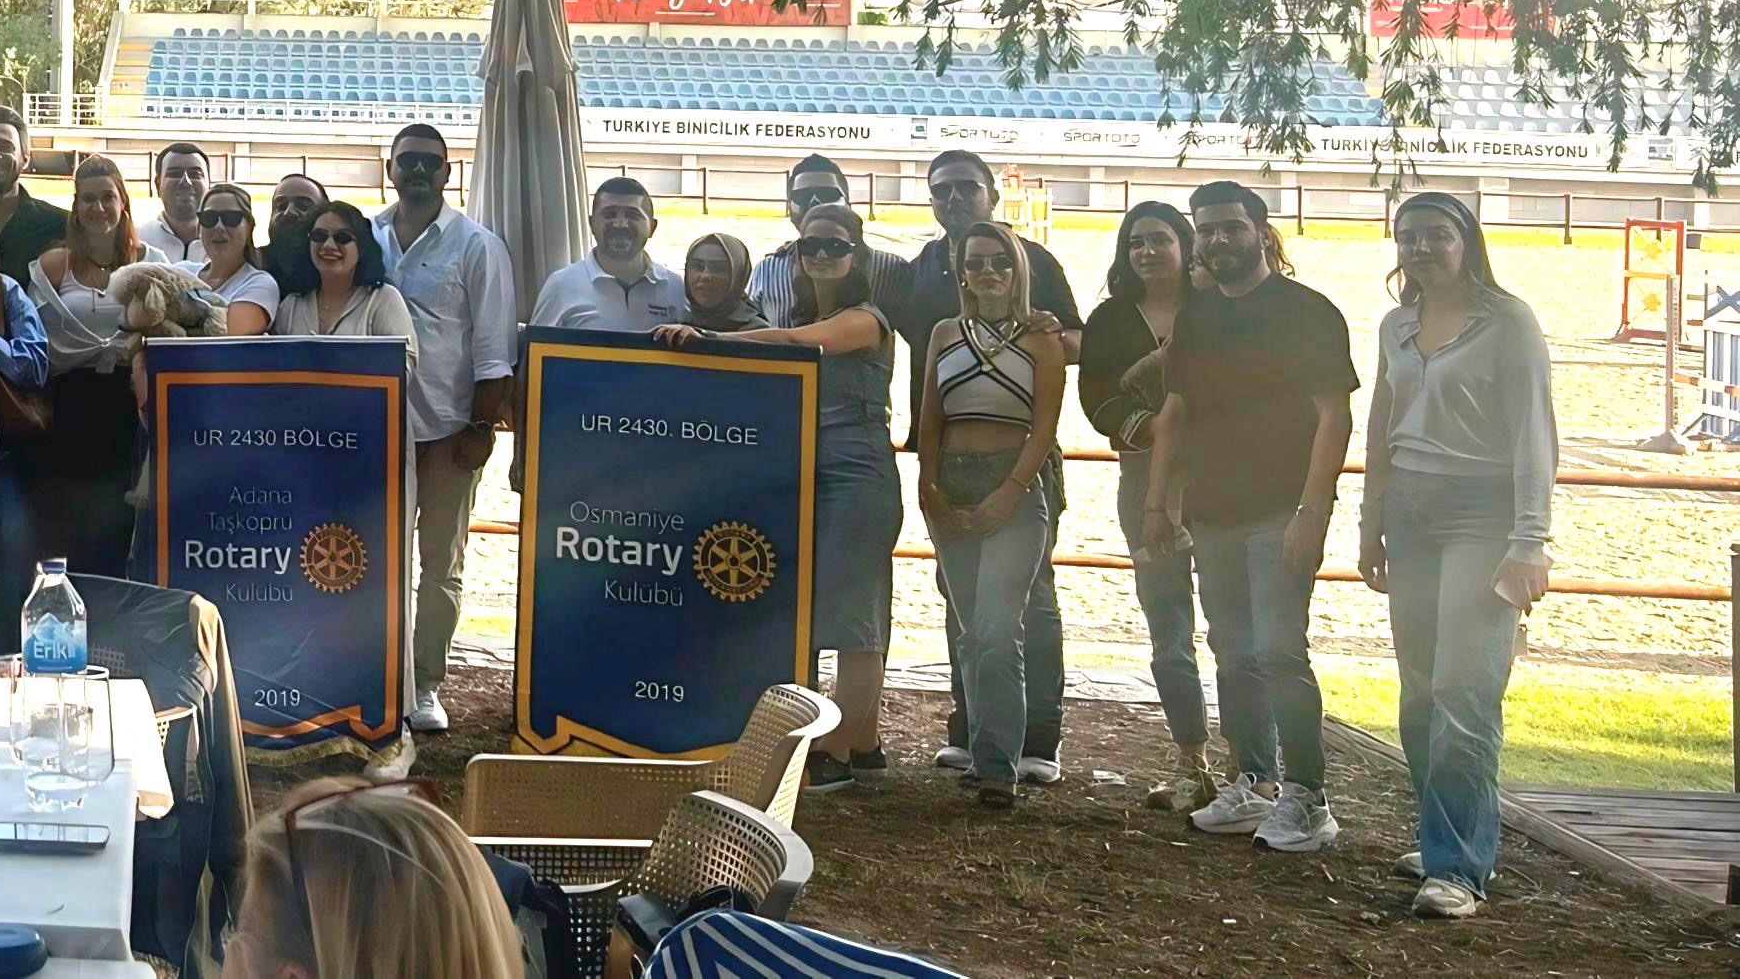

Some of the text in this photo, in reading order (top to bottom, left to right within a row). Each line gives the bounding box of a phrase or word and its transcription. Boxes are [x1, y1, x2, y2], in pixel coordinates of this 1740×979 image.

[756, 124, 871, 139] FEDERASYONU
[1473, 141, 1588, 158] FEDERASYONU
[194, 430, 224, 446] UR
[230, 429, 277, 446] 2430
[581, 414, 759, 445] UR 2430. BÖLGE
[228, 486, 293, 504] Adana
[570, 501, 685, 535] Osmaniye
[185, 540, 292, 575] Rotary
[556, 527, 684, 577] Rotary
[604, 580, 684, 607] Kulübü
[254, 688, 301, 707] 2019
[634, 680, 685, 703] 2019
